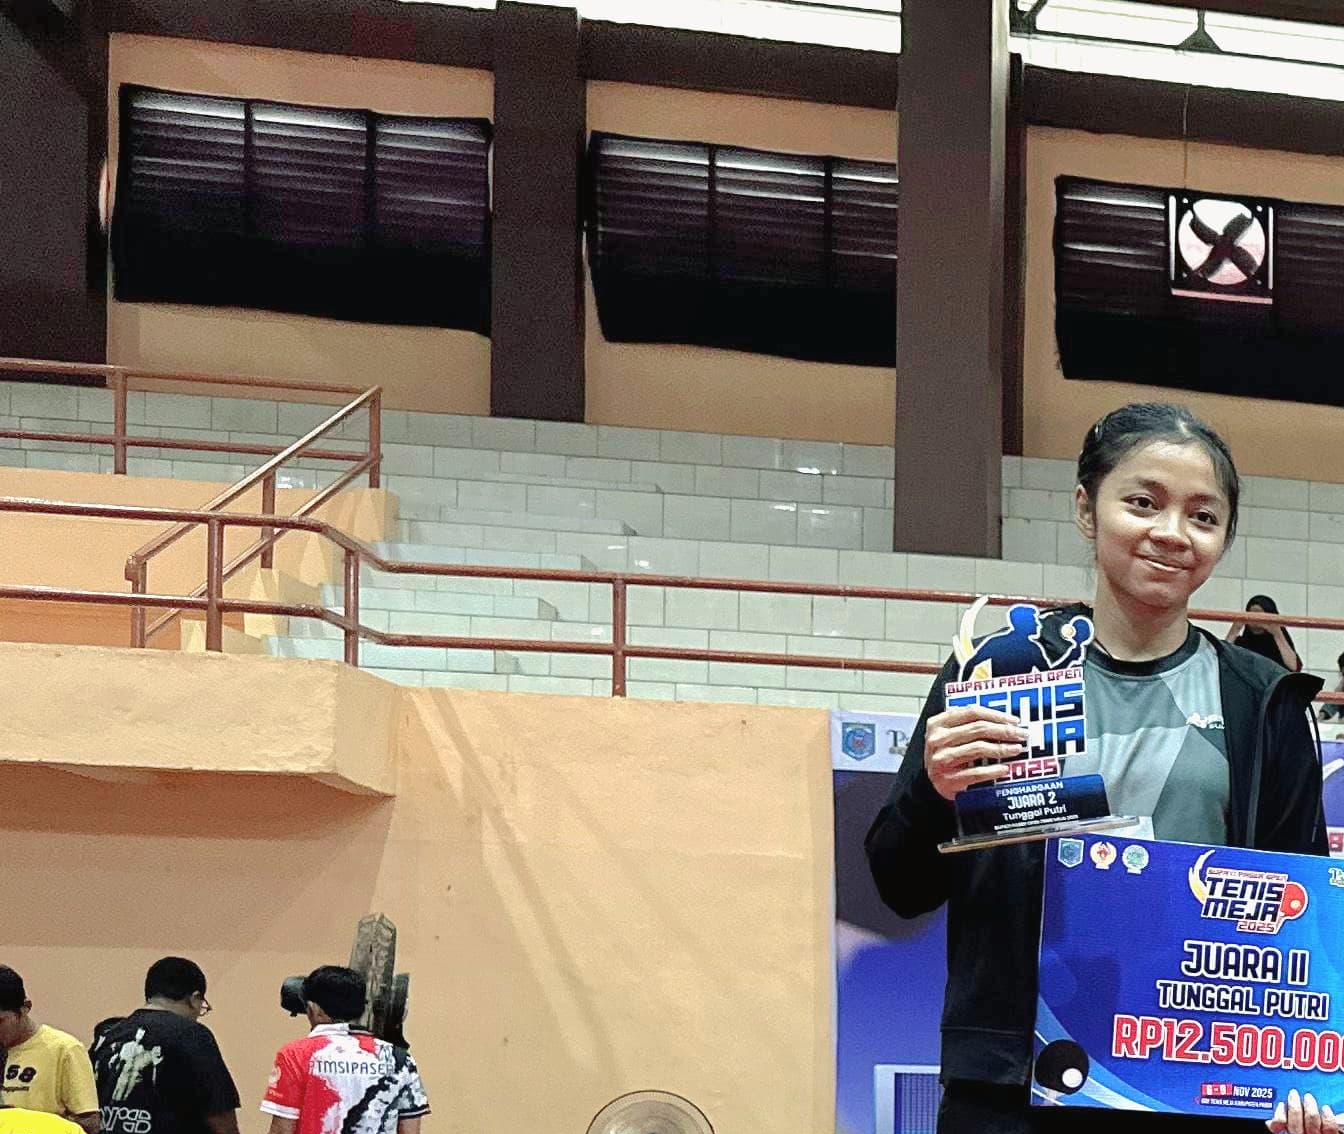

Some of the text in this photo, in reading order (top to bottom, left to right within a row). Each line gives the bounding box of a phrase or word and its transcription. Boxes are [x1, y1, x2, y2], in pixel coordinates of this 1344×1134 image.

[947, 668, 1082, 694] BUPATI PASER OPEN
[1002, 803, 1067, 821] Tunggal Putri
[1007, 791, 1058, 810] JUARA 2
[1206, 877, 1285, 901] TENIS
[1203, 899, 1281, 922] MEJA
[1238, 920, 1275, 932] 2025
[1184, 942, 1307, 983] JUARA II
[1158, 981, 1328, 1018] TUNGGAL PUTRI
[1251, 1087, 1273, 1098] 2025
